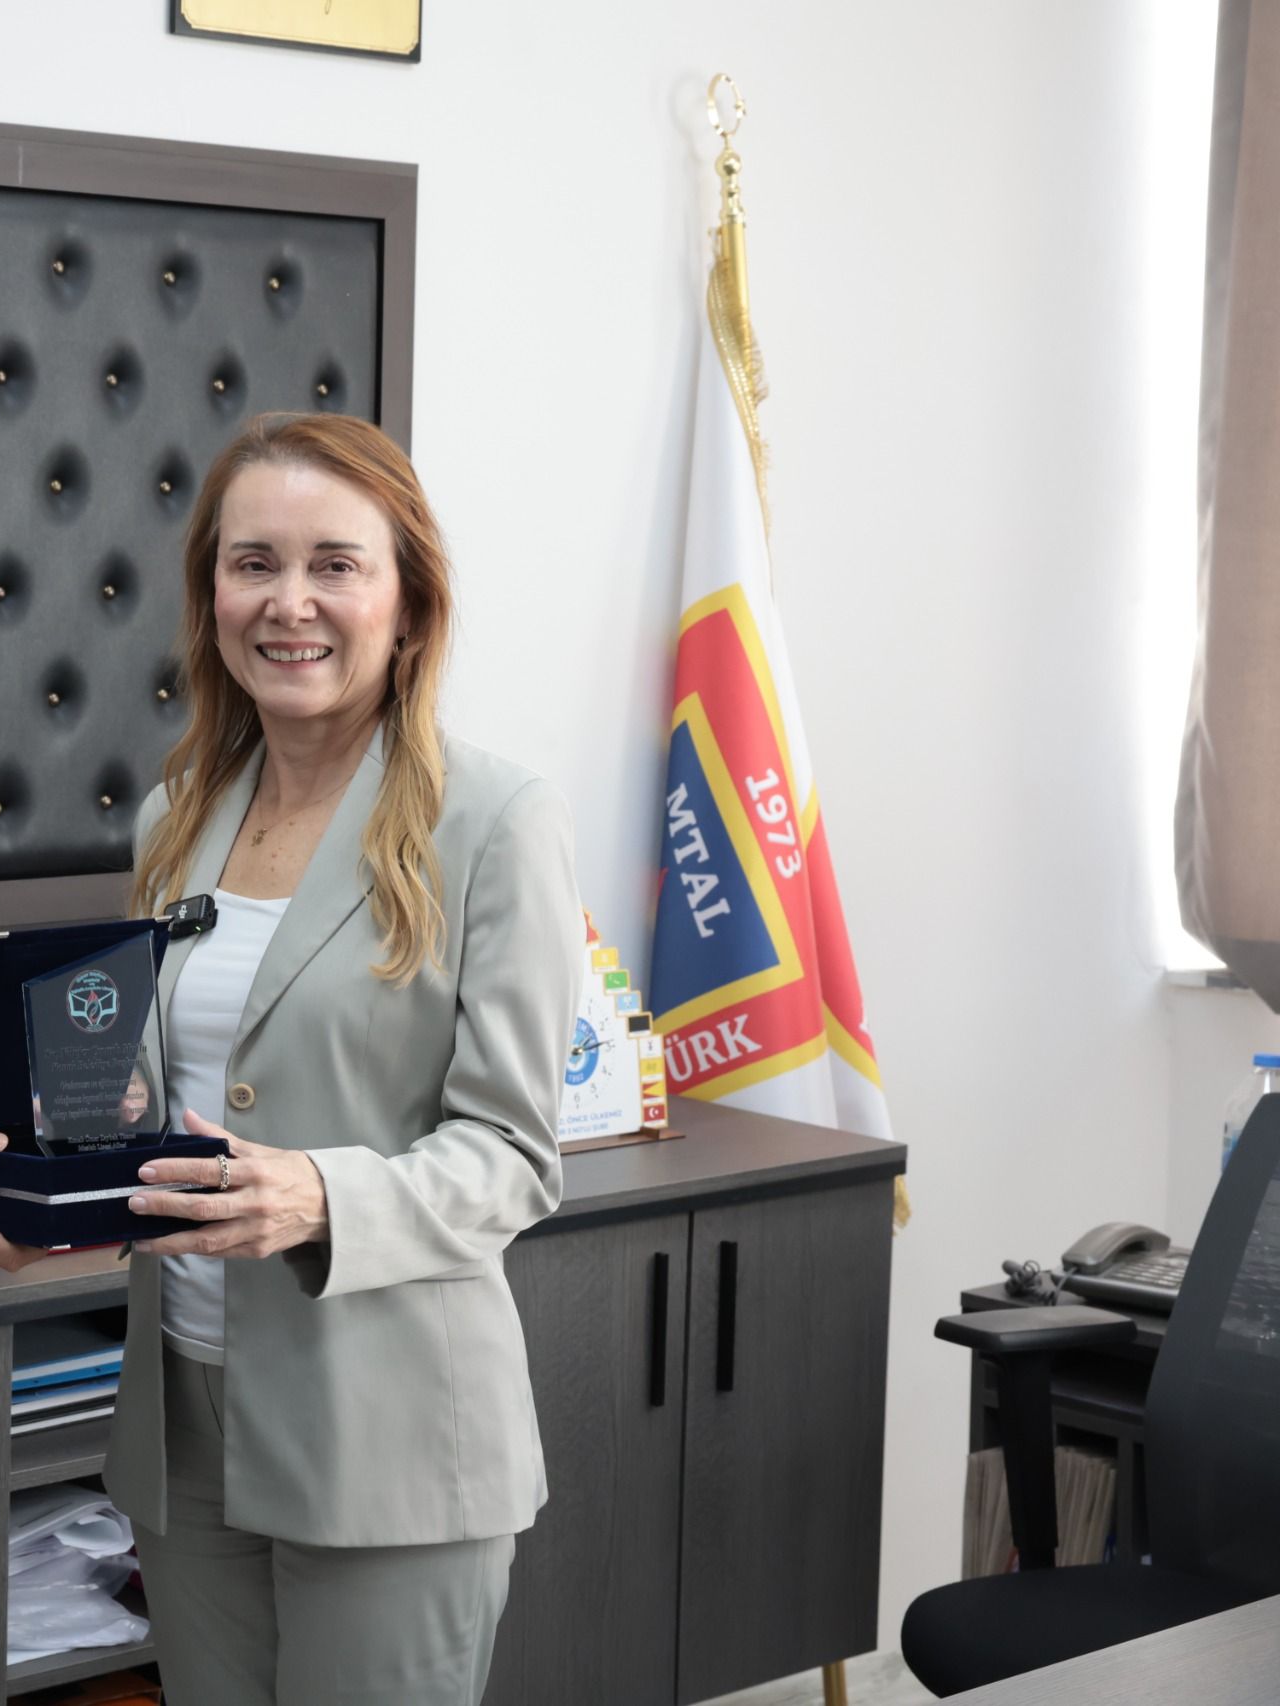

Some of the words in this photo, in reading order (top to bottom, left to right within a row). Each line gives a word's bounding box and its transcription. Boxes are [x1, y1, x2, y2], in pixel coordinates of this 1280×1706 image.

[666, 782, 732, 939] MTAL
[745, 768, 803, 880] 1973
[663, 1013, 763, 1083] ÜRK
